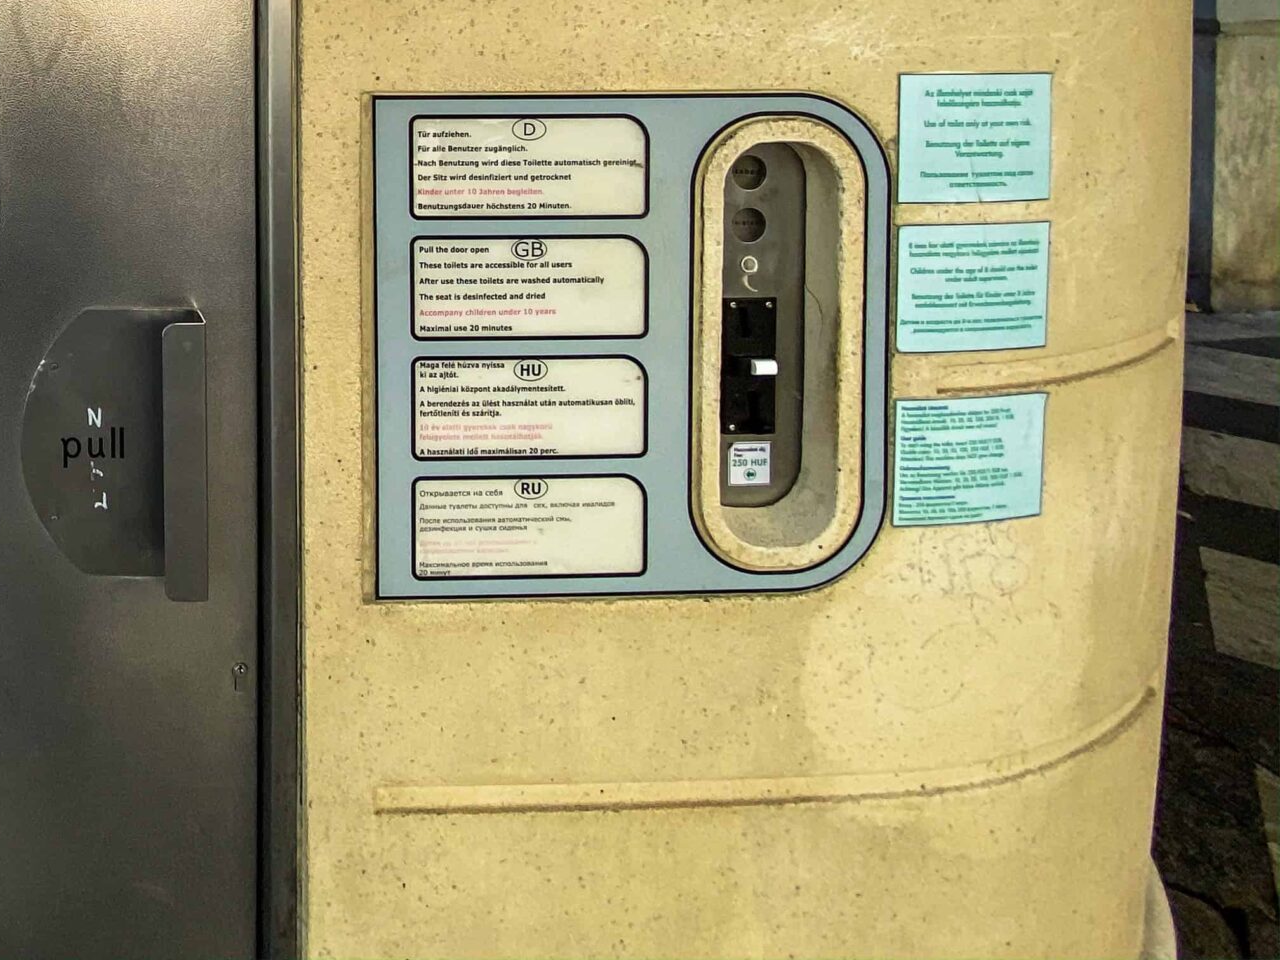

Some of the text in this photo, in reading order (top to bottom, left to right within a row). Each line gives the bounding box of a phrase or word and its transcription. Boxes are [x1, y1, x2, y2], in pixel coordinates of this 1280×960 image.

[524, 123, 535, 136] D
[485, 145, 528, 153] zugänglich.
[439, 160, 479, 168] Benutzung
[531, 174, 571, 182] getrocknet
[418, 203, 484, 211] Benutzungsdauer
[515, 243, 543, 257] GB
[420, 308, 462, 317] Accompany
[420, 362, 439, 370] Maga
[520, 364, 541, 376] HU
[461, 386, 490, 394] központ
[61, 427, 124, 468] pull
[521, 483, 541, 495] RU
